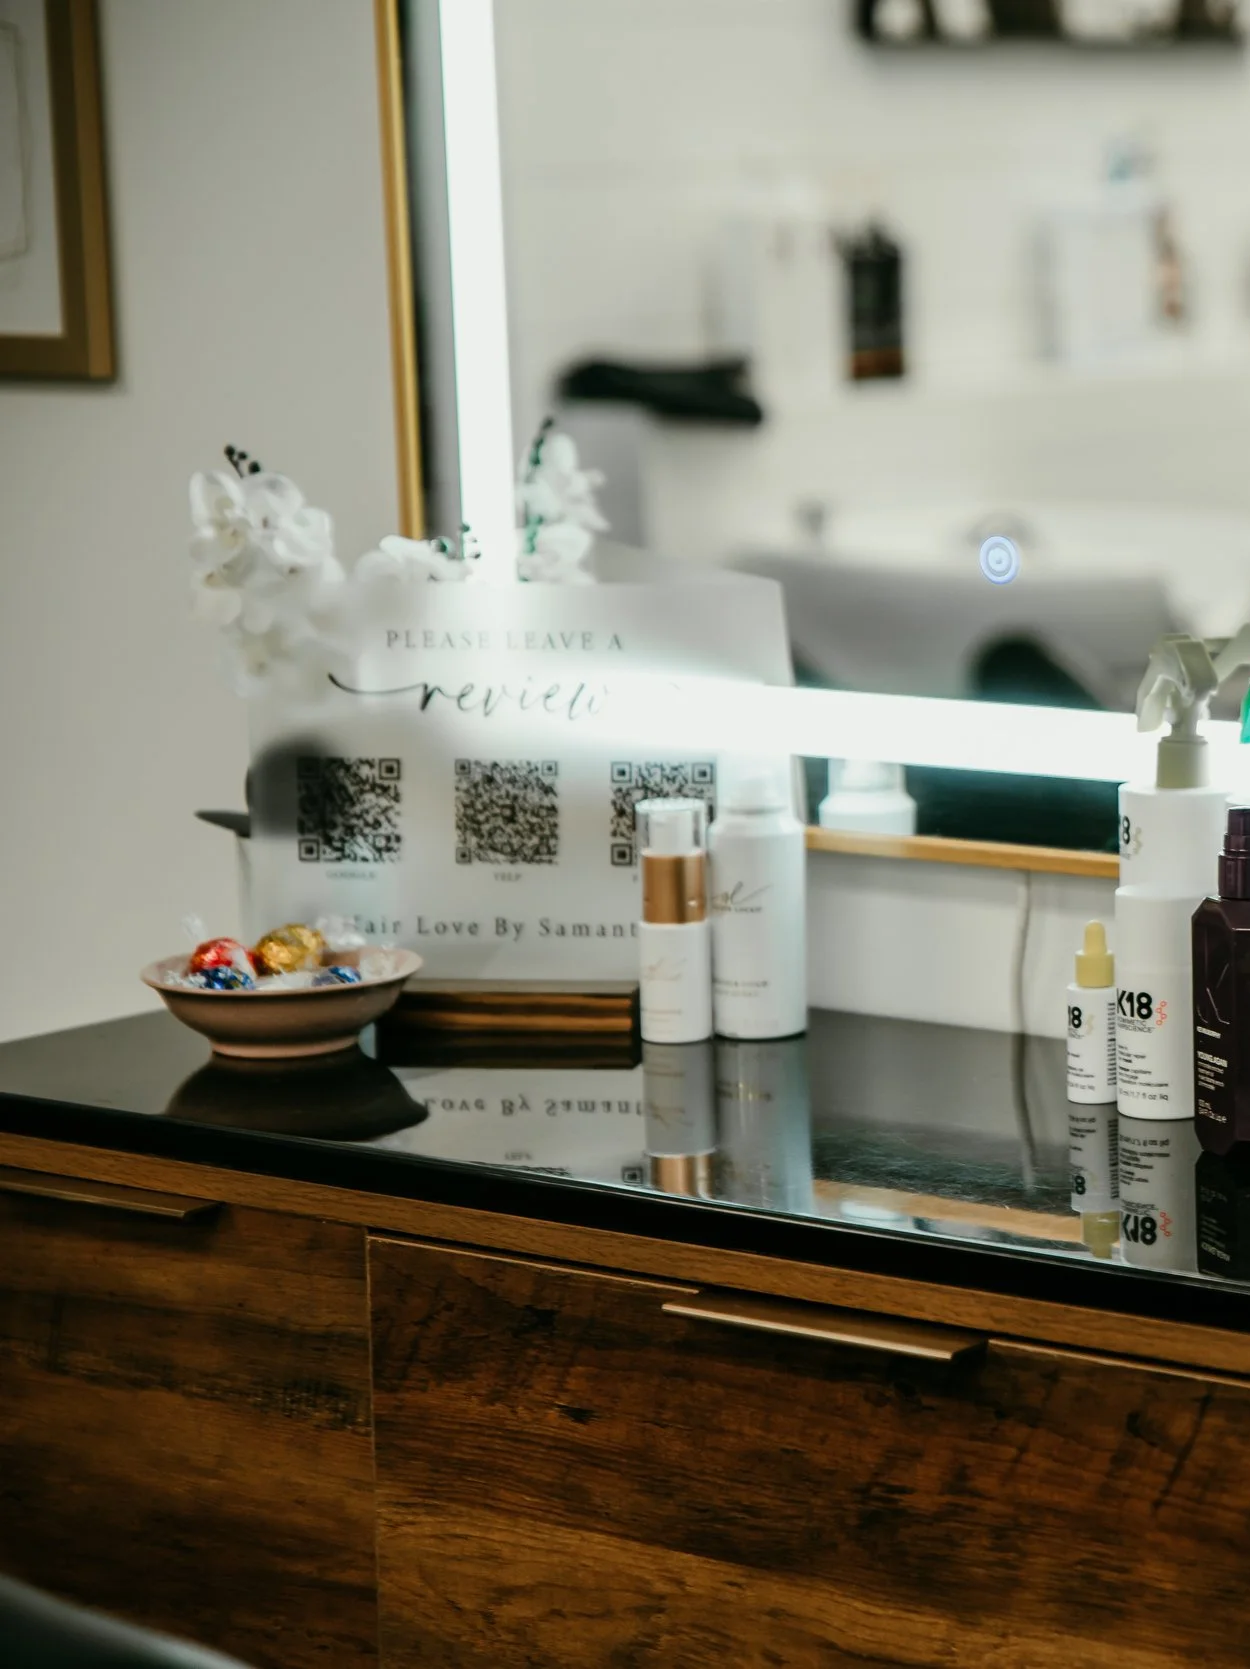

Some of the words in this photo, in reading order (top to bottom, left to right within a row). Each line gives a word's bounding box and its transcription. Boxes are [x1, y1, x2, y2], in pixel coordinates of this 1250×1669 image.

[385, 628, 491, 649] PLEASE
[505, 630, 594, 650] LEAVE
[607, 632, 624, 651] A
[352, 914, 401, 935] air
[416, 915, 479, 936] Love
[494, 916, 525, 941] By
[538, 917, 639, 938] Samant
[1116, 988, 1153, 1020] K18
[1068, 1005, 1082, 1029] 18
